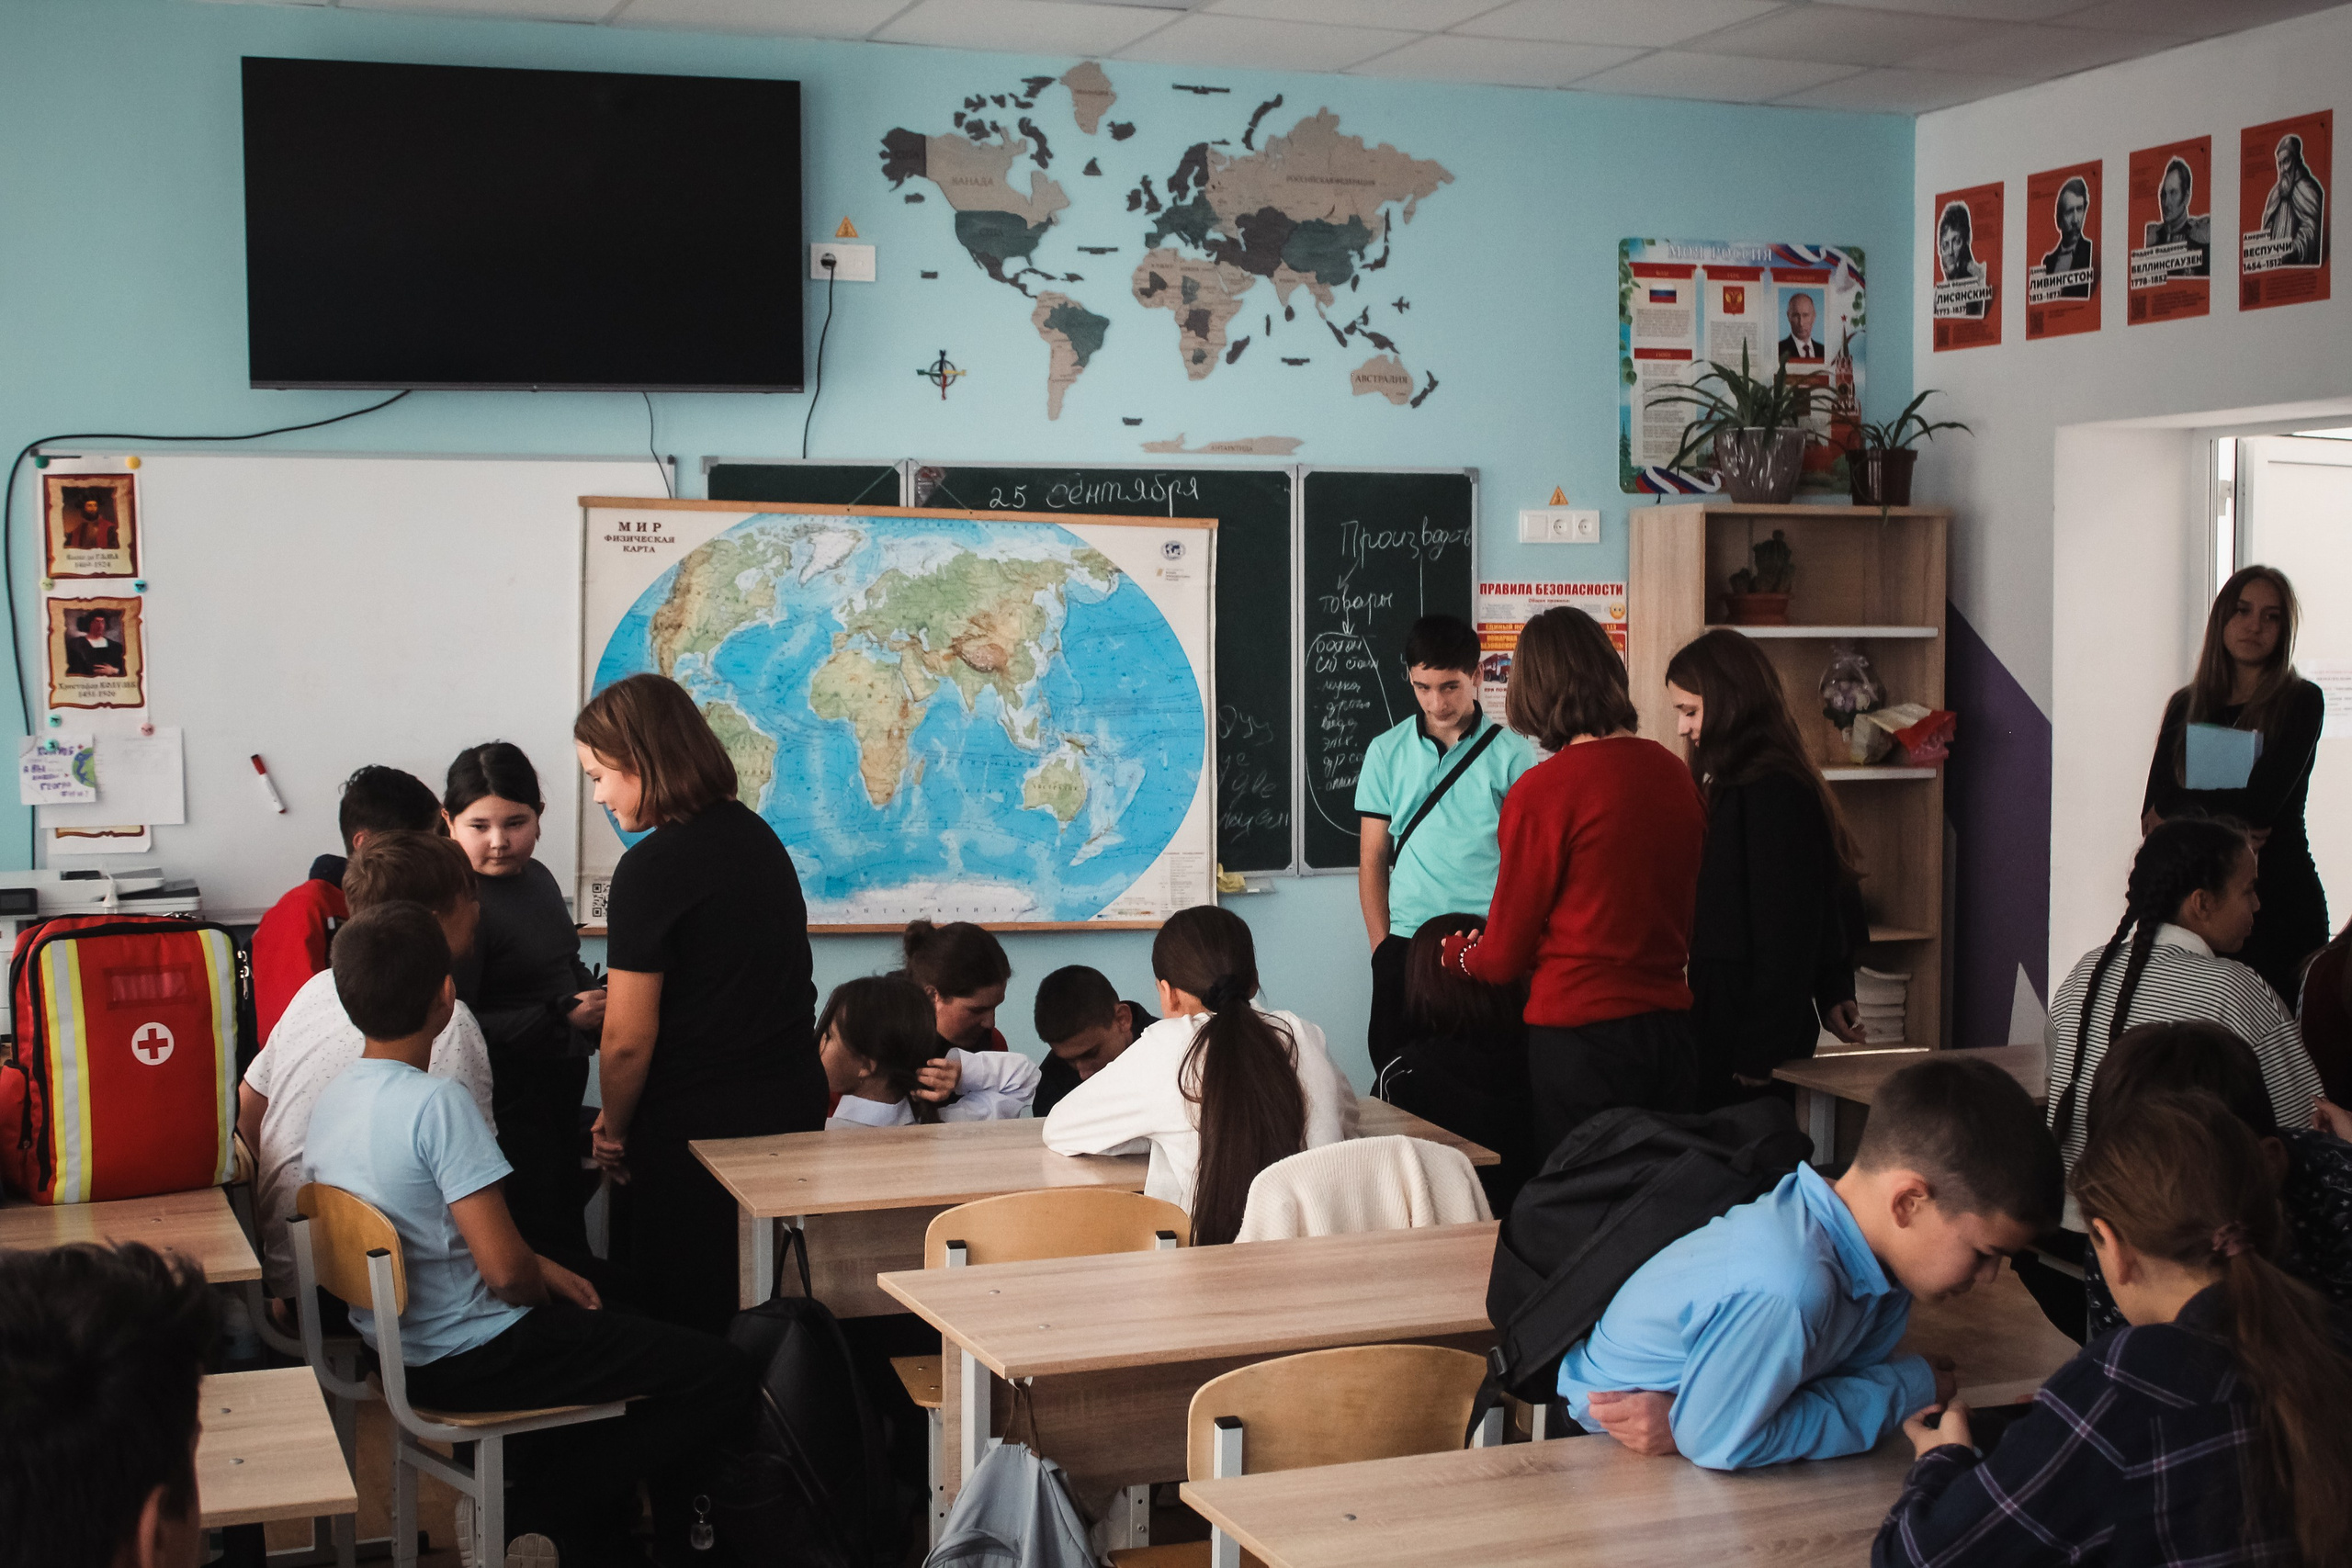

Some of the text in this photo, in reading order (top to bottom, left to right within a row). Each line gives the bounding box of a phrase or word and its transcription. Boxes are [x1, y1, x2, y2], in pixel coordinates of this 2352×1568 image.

[2243, 241, 2292, 258] ВЕСПУЧЧИ
[2132, 254, 2202, 275] БЕЛЛИНСГАУЗЕН
[2030, 270, 2094, 291] ЛИВИНГСТОН
[1355, 374, 1408, 384] АВСТРАЛИЯ
[989, 485, 1027, 509] 25
[618, 522, 662, 532] МИР
[605, 535, 675, 543] ФИЗИЧЕСКАЯ
[1479, 583, 1623, 596] ПРАВИЛА БЕЗОПАСНОСТИ
